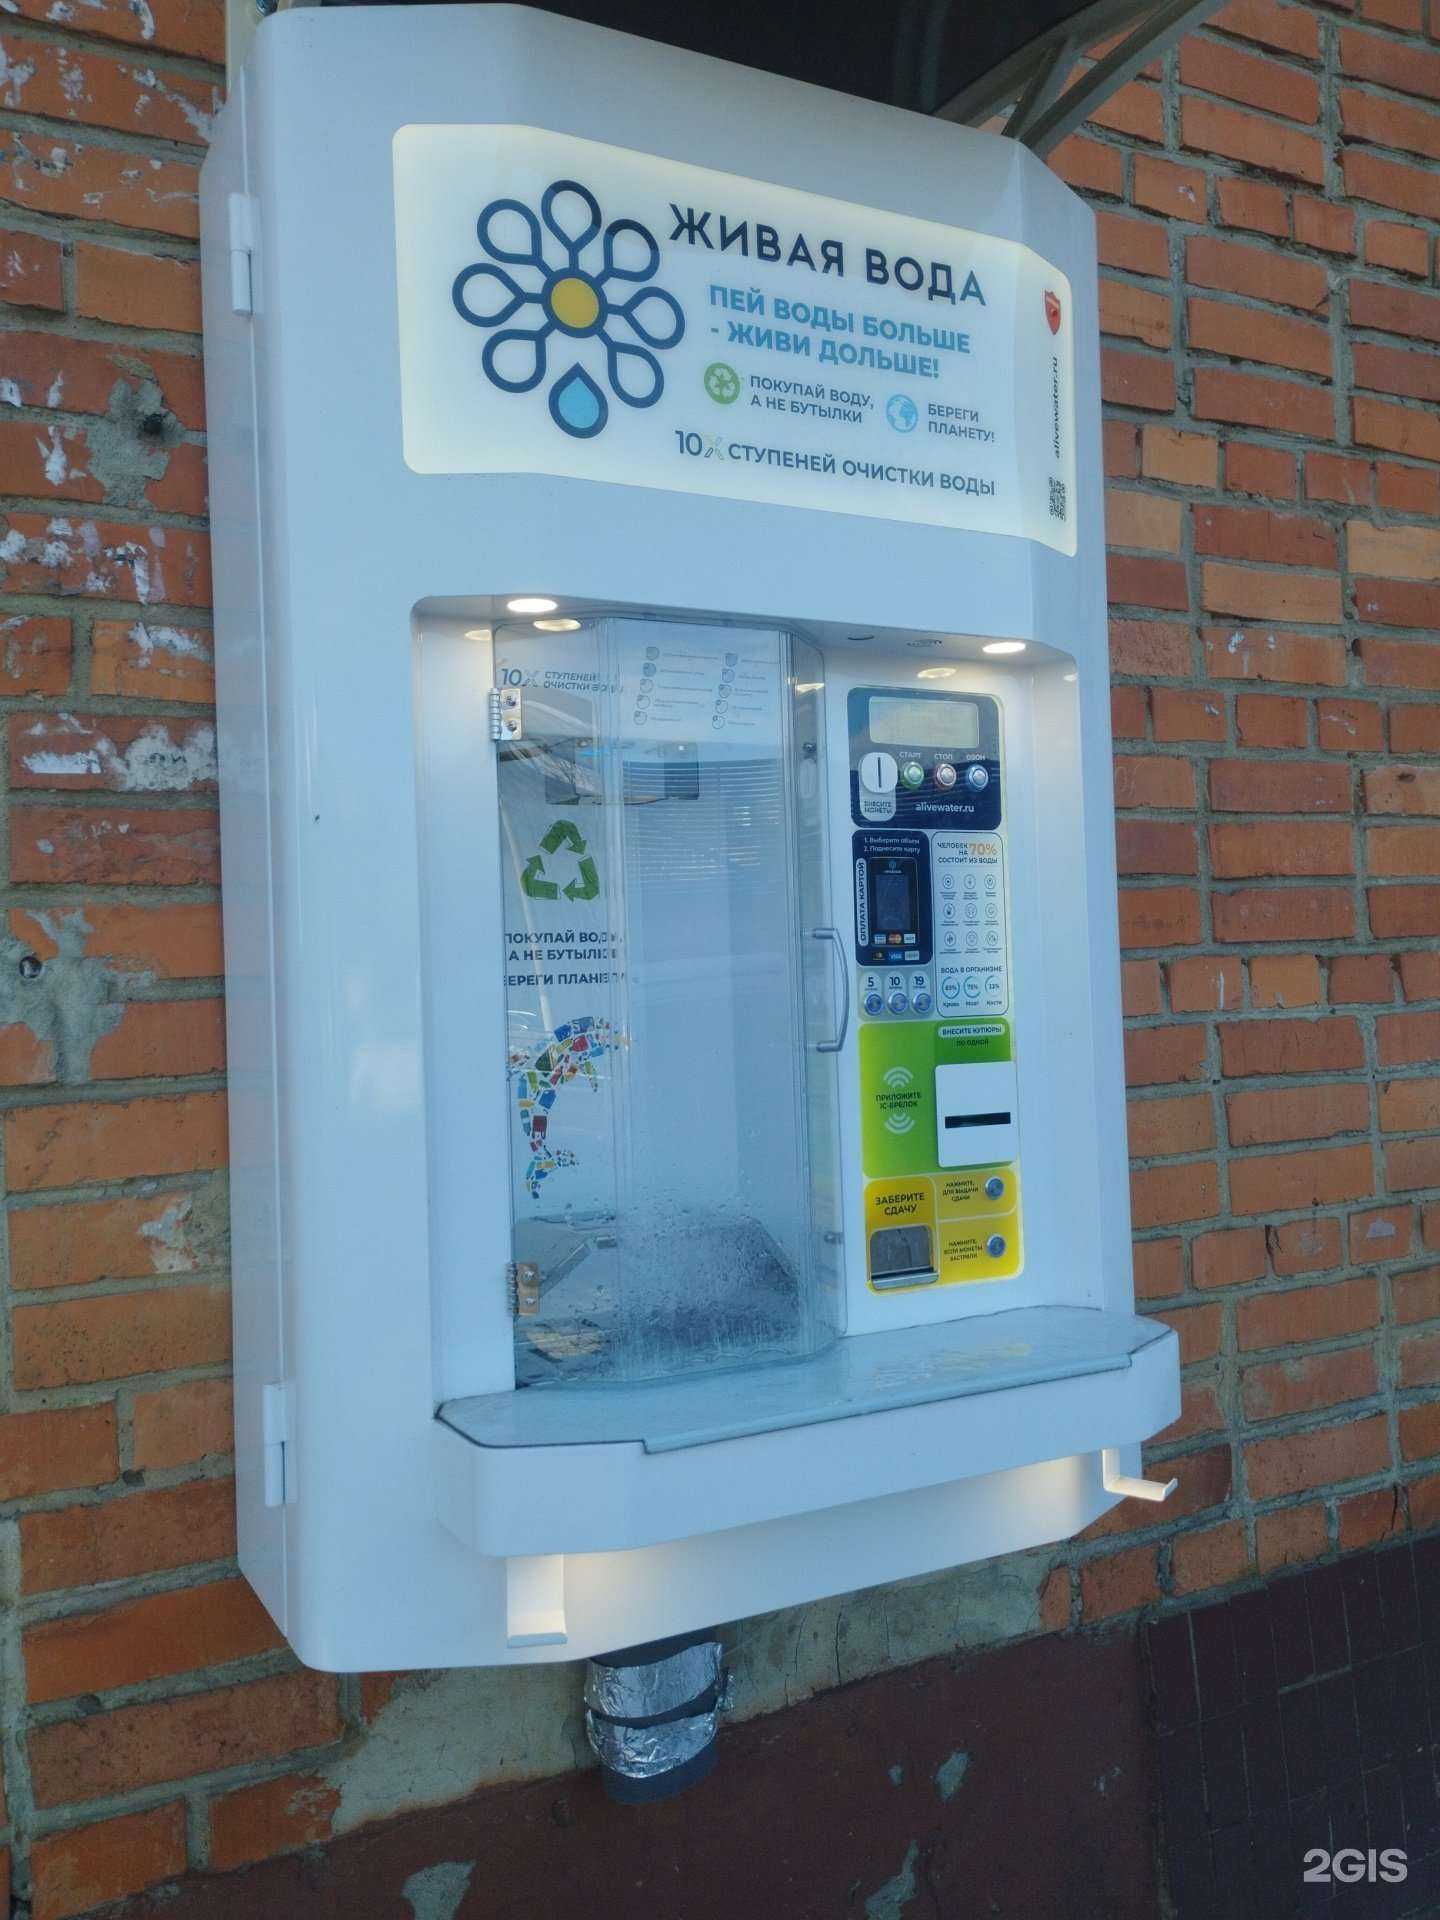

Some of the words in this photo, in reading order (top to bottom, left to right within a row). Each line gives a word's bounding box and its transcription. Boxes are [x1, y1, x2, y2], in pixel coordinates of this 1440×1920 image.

[669, 203, 844, 277] ЖИВАЯ
[866, 248, 986, 306] ВОДА
[710, 284, 765, 316] ПЕЙ
[774, 298, 854, 333] ВОДЫ
[863, 315, 970, 354] БОЛЬШЕ
[727, 321, 811, 357] ЖИВИ
[818, 339, 940, 379] ДОЛЬШЕ!
[750, 375, 825, 400] ПОКУПАЙ
[830, 388, 874, 410] ВОДУ,
[751, 394, 762, 407] А
[766, 397, 786, 412] НЕ
[791, 402, 862, 424] БУТЫЛКИ
[928, 403, 979, 423] БЕРЕГИ
[1052, 356, 1061, 460] alivewater.ru
[928, 421, 995, 443] ПЛАНЕТУ!
[728, 443, 836, 474] СТУПЕНЕЙ
[842, 460, 934, 488] ОЧИСТКИ
[940, 473, 995, 497] ВОДЫ
[915, 801, 975, 813] alivewater.ru
[969, 842, 997, 856] 70%
[857, 861, 866, 898] КАРТОЙ
[859, 902, 867, 941] ОПЛАТА
[508, 950, 520, 961] А
[523, 949, 543, 961] НЕ
[868, 976, 874, 988] 5
[889, 976, 900, 986] 10
[914, 975, 925, 986] 19
[942, 1027, 971, 1036] ВНЕСИТЕ
[973, 1025, 1002, 1034] КУПЮРЫ
[875, 1090, 921, 1102] ПРИЛОЖИТЕ
[875, 1192, 925, 1206] ЗАБЕРИТЕ
[884, 1203, 917, 1216] СДАЧУ
